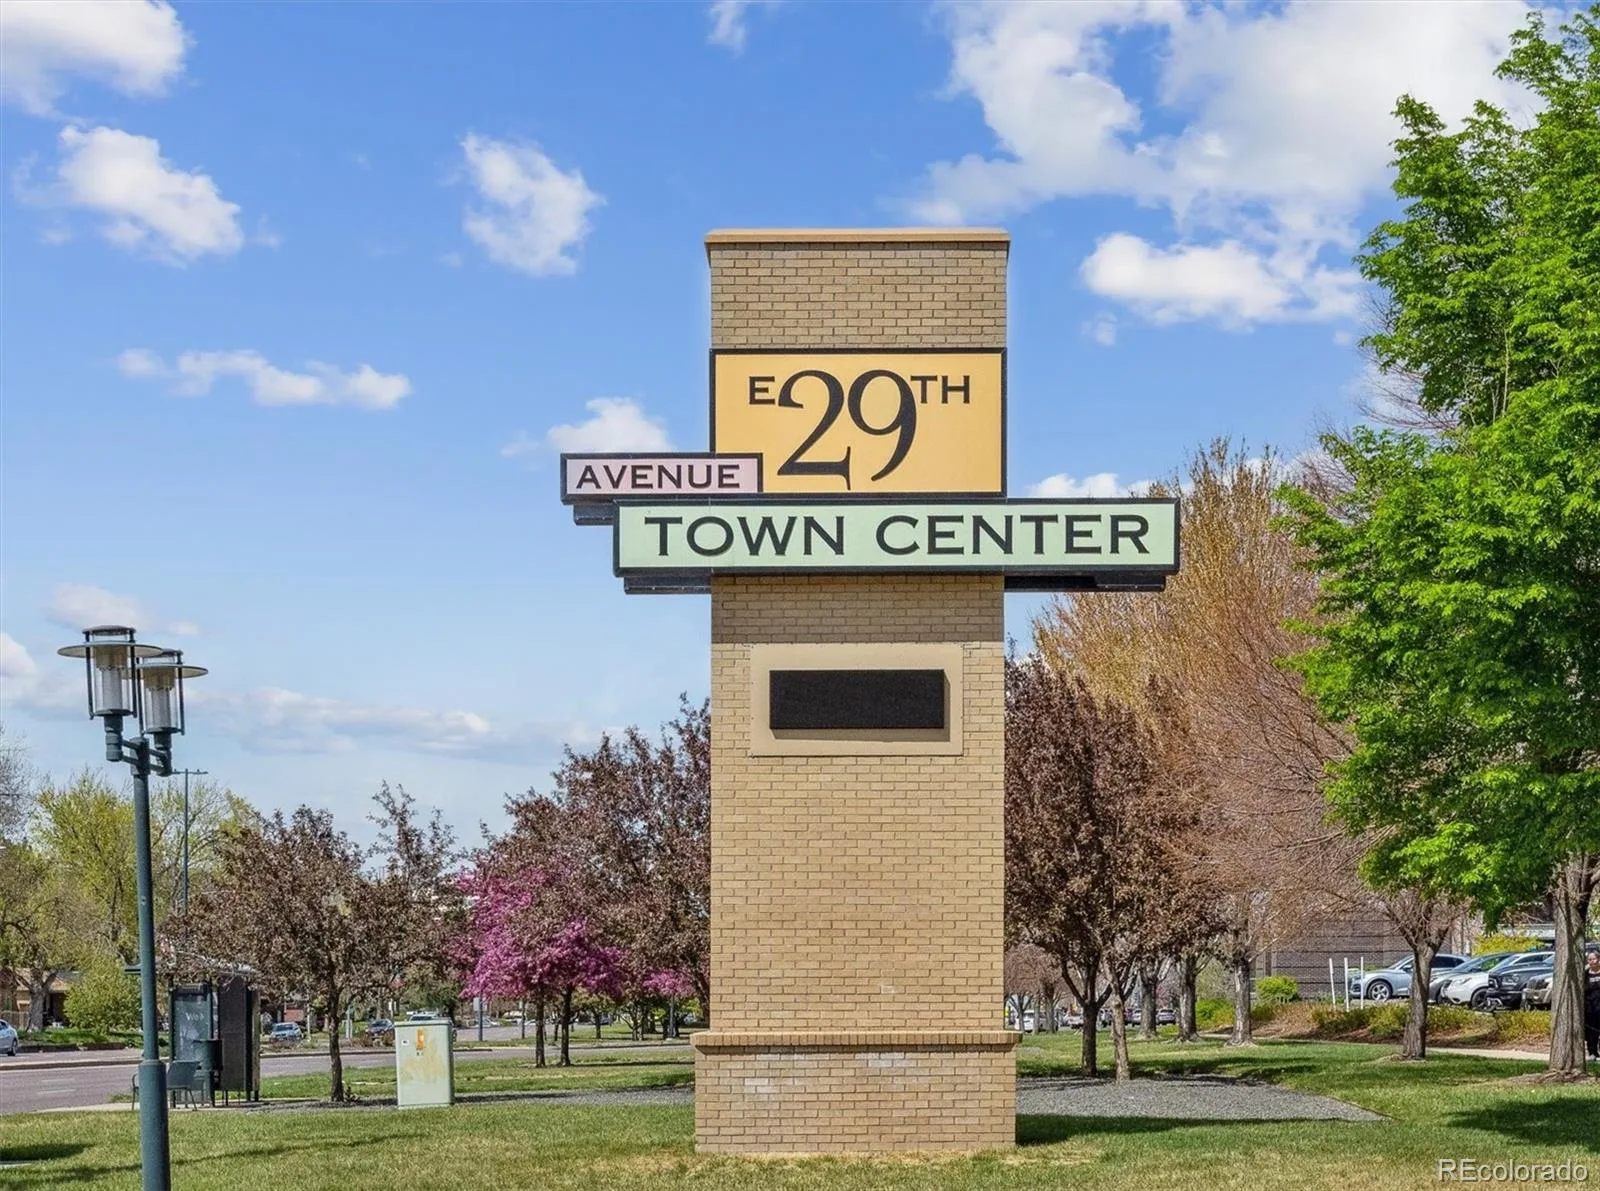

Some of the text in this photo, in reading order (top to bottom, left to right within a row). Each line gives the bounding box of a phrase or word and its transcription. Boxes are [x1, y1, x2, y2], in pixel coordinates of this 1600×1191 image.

[576, 464, 740, 489] AVENUE
[645, 514, 1150, 556] TOWN CENTER
